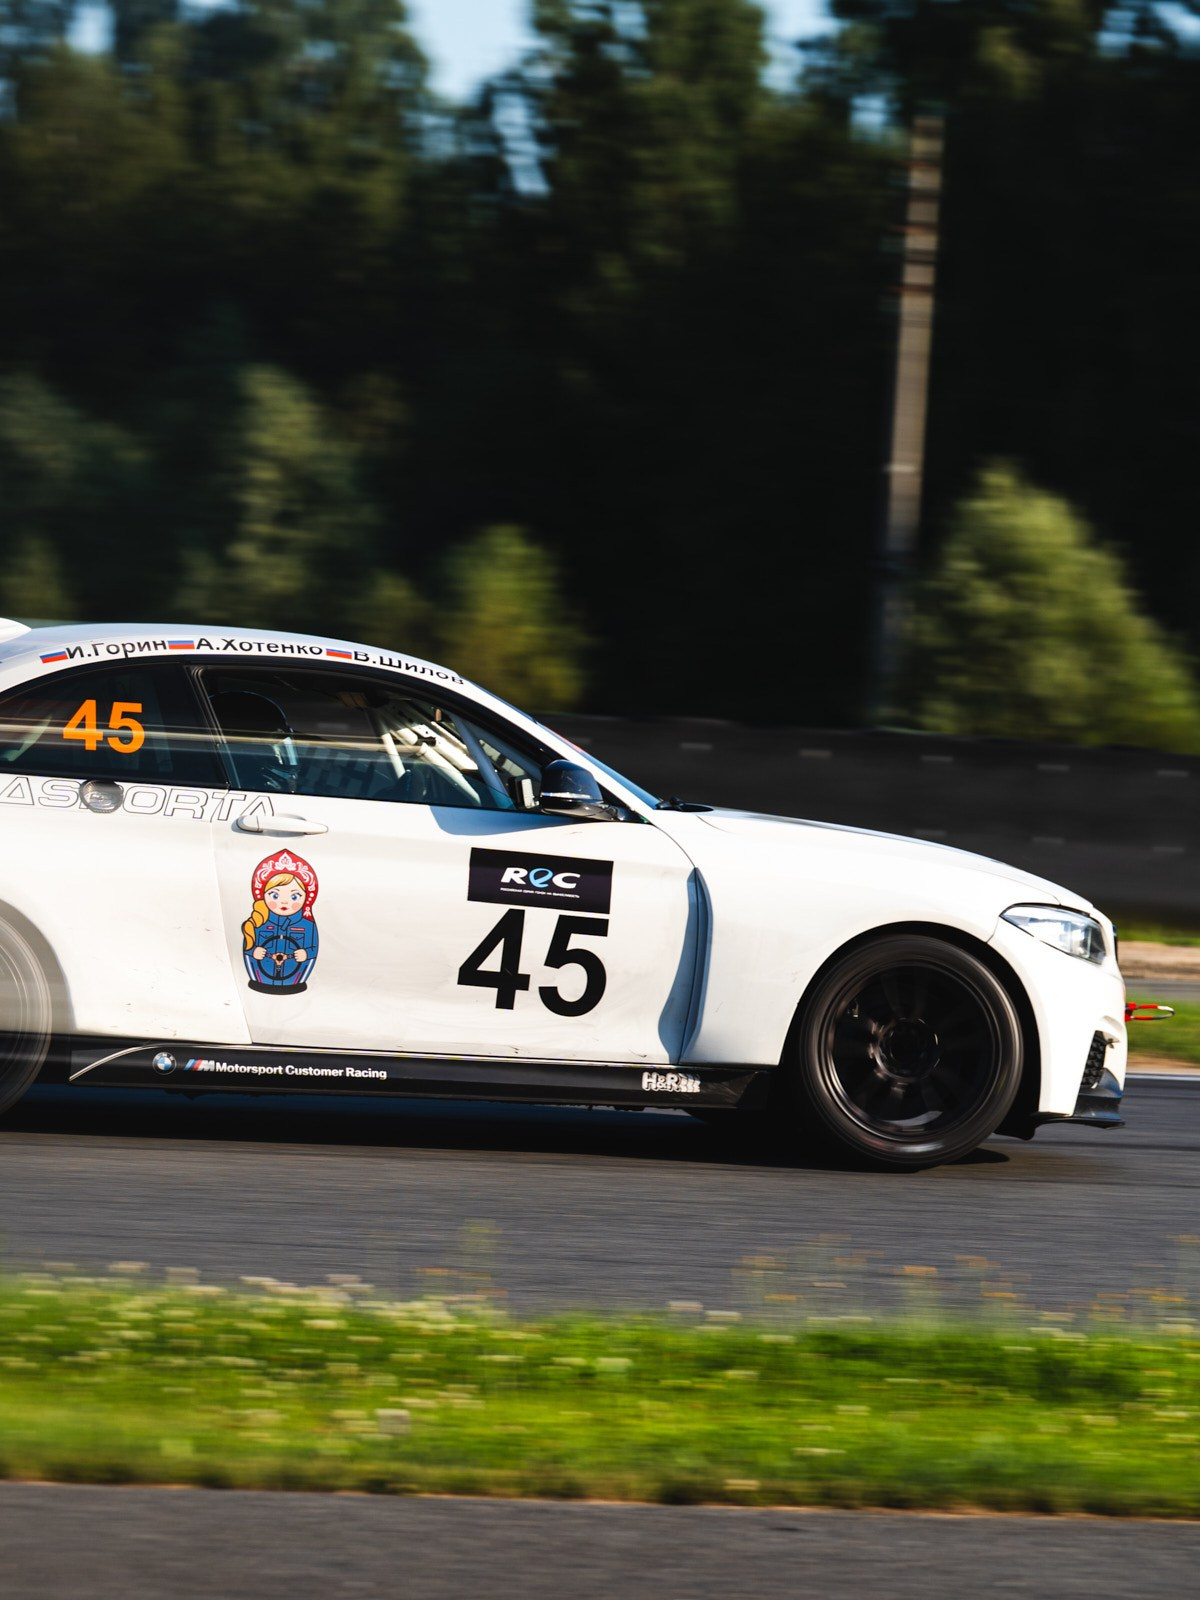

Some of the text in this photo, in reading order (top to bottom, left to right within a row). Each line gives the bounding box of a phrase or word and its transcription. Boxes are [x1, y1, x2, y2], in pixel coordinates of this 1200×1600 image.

[66, 638, 465, 685] И.Горин А.Хотенко В.Шилов
[63, 699, 145, 753] 45
[457, 908, 609, 1017] 45
[215, 1062, 284, 1076] Motorsport
[285, 1065, 344, 1077] Customer
[345, 1067, 388, 1080] Racing
[642, 1071, 681, 1092] H&R
